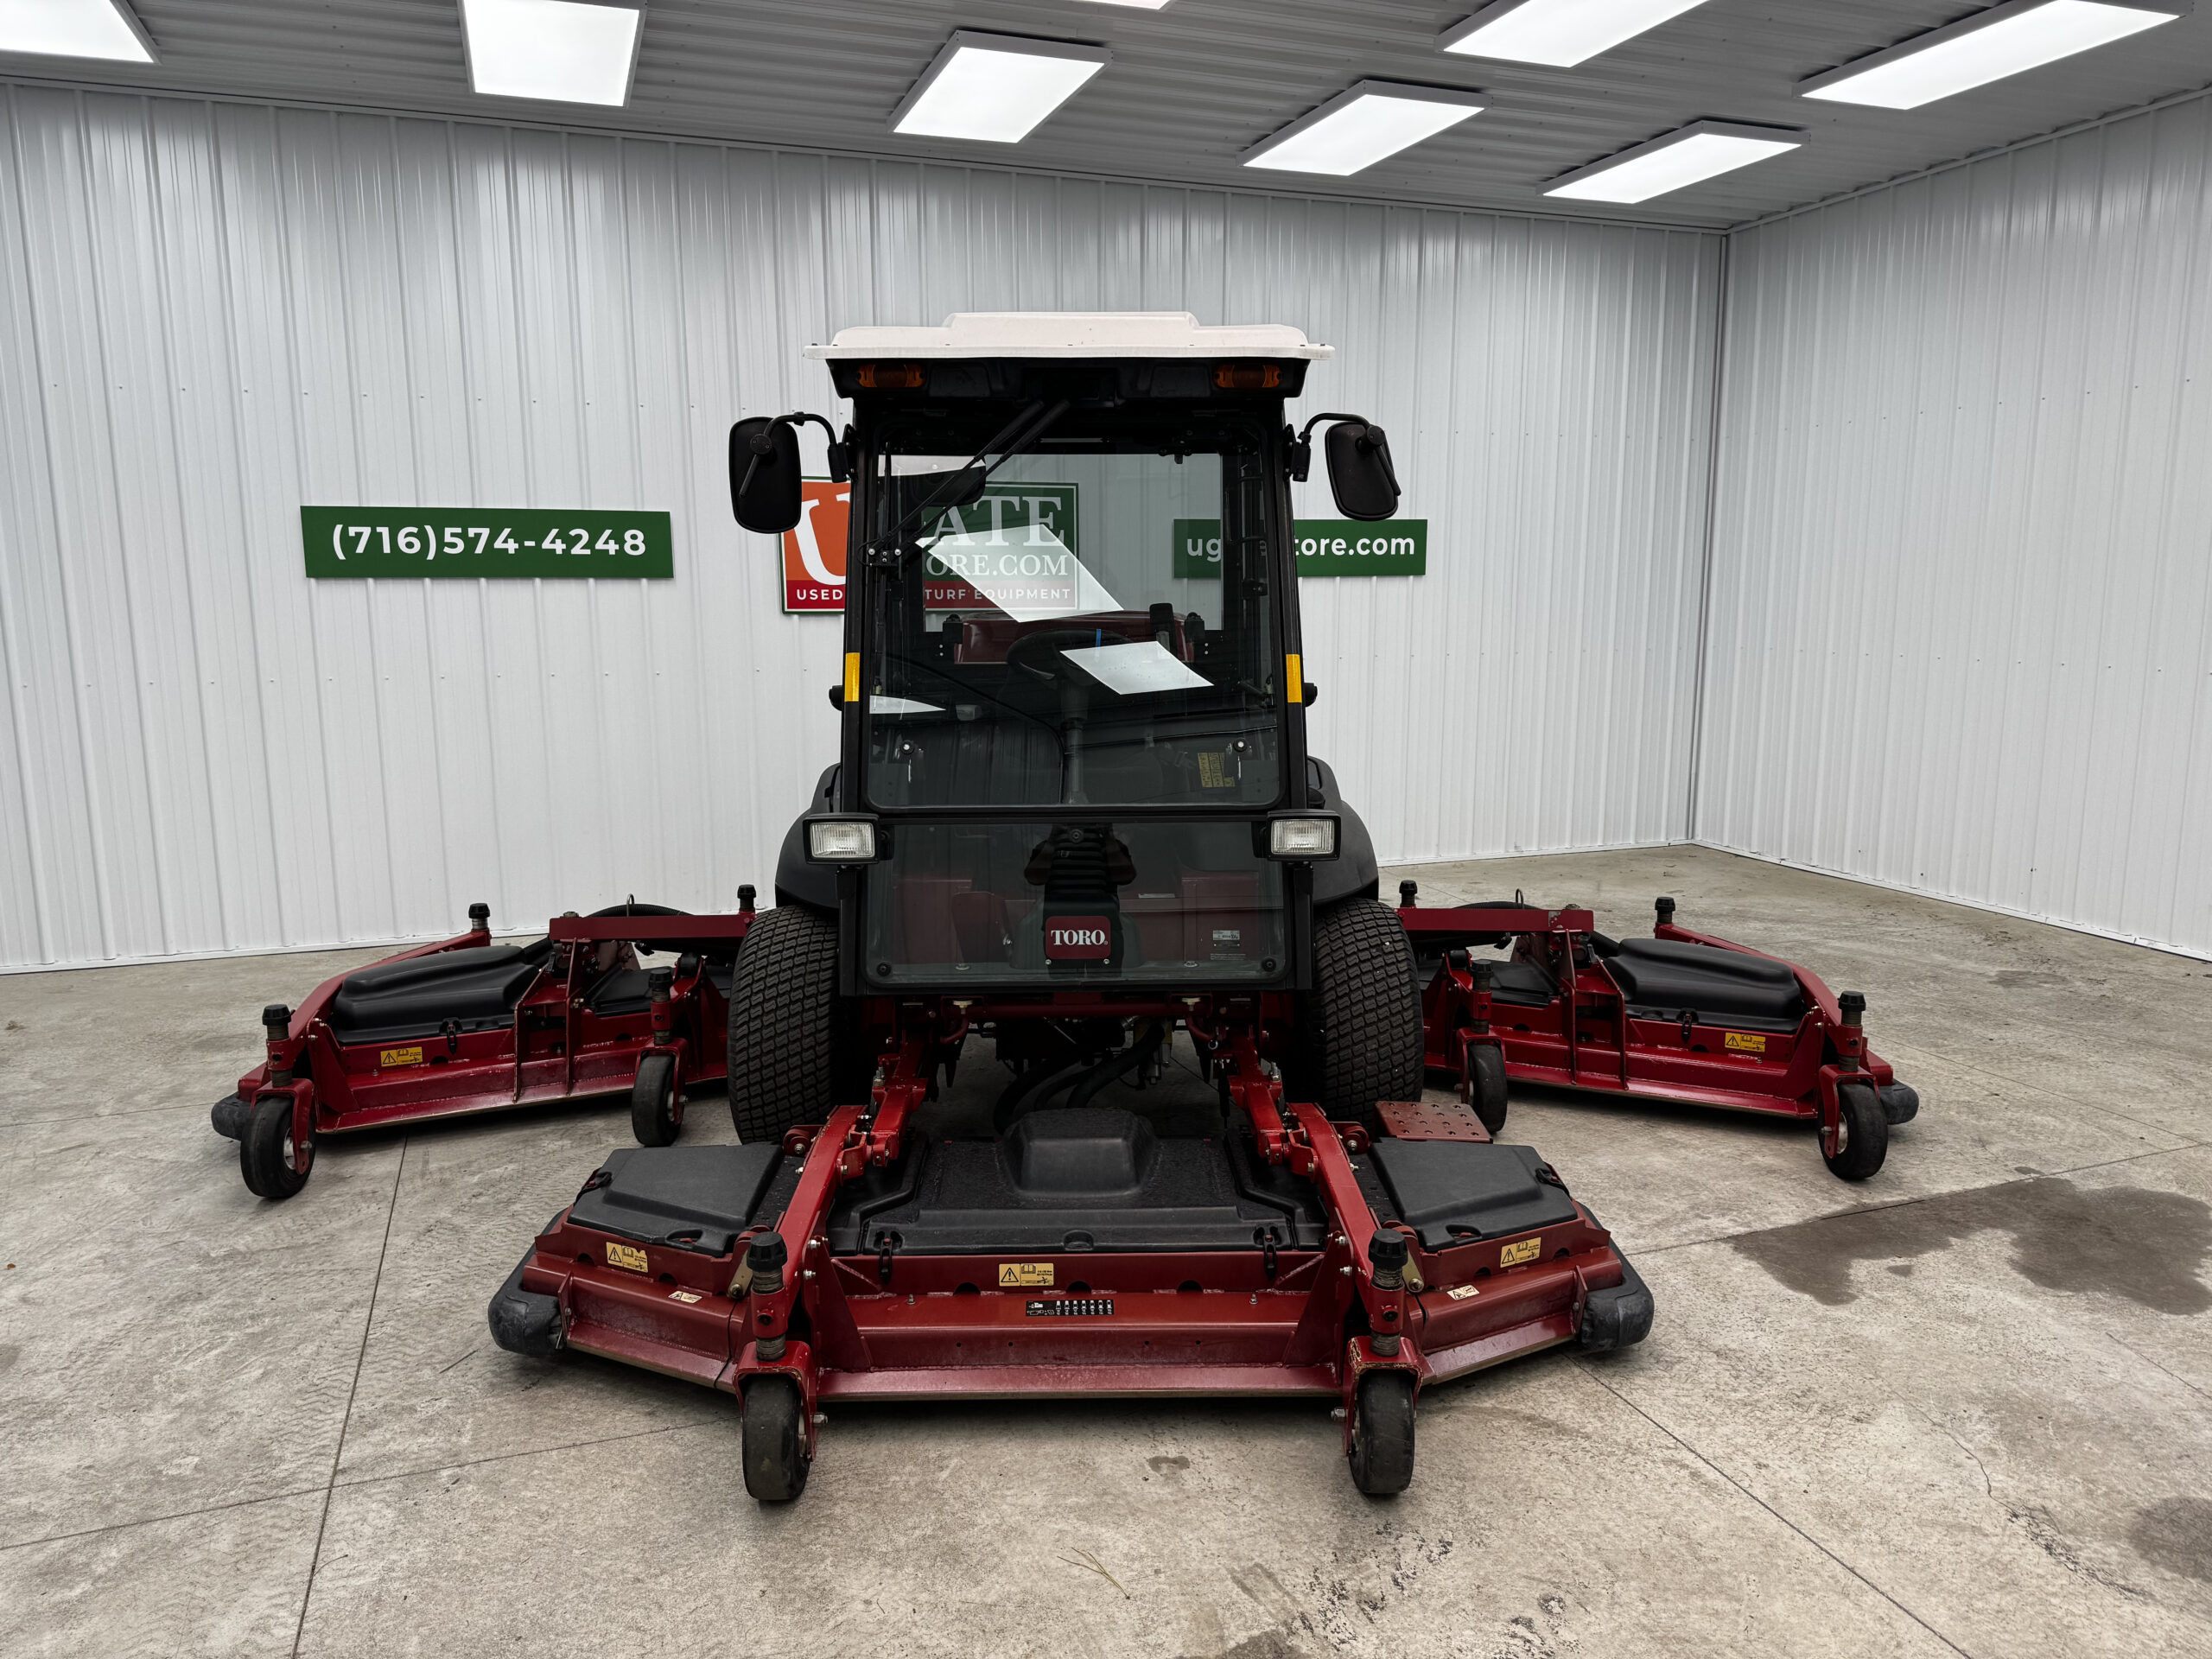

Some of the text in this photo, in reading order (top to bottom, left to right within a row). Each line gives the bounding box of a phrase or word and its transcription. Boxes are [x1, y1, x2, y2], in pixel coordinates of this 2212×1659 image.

[930, 495, 1065, 546] ATE
[333, 524, 646, 560] (716)574-4248
[925, 554, 1068, 575] ORE.COM
[797, 588, 1071, 600] USED TURF EQUIPMENT
[1051, 929, 1106, 945] TORO
